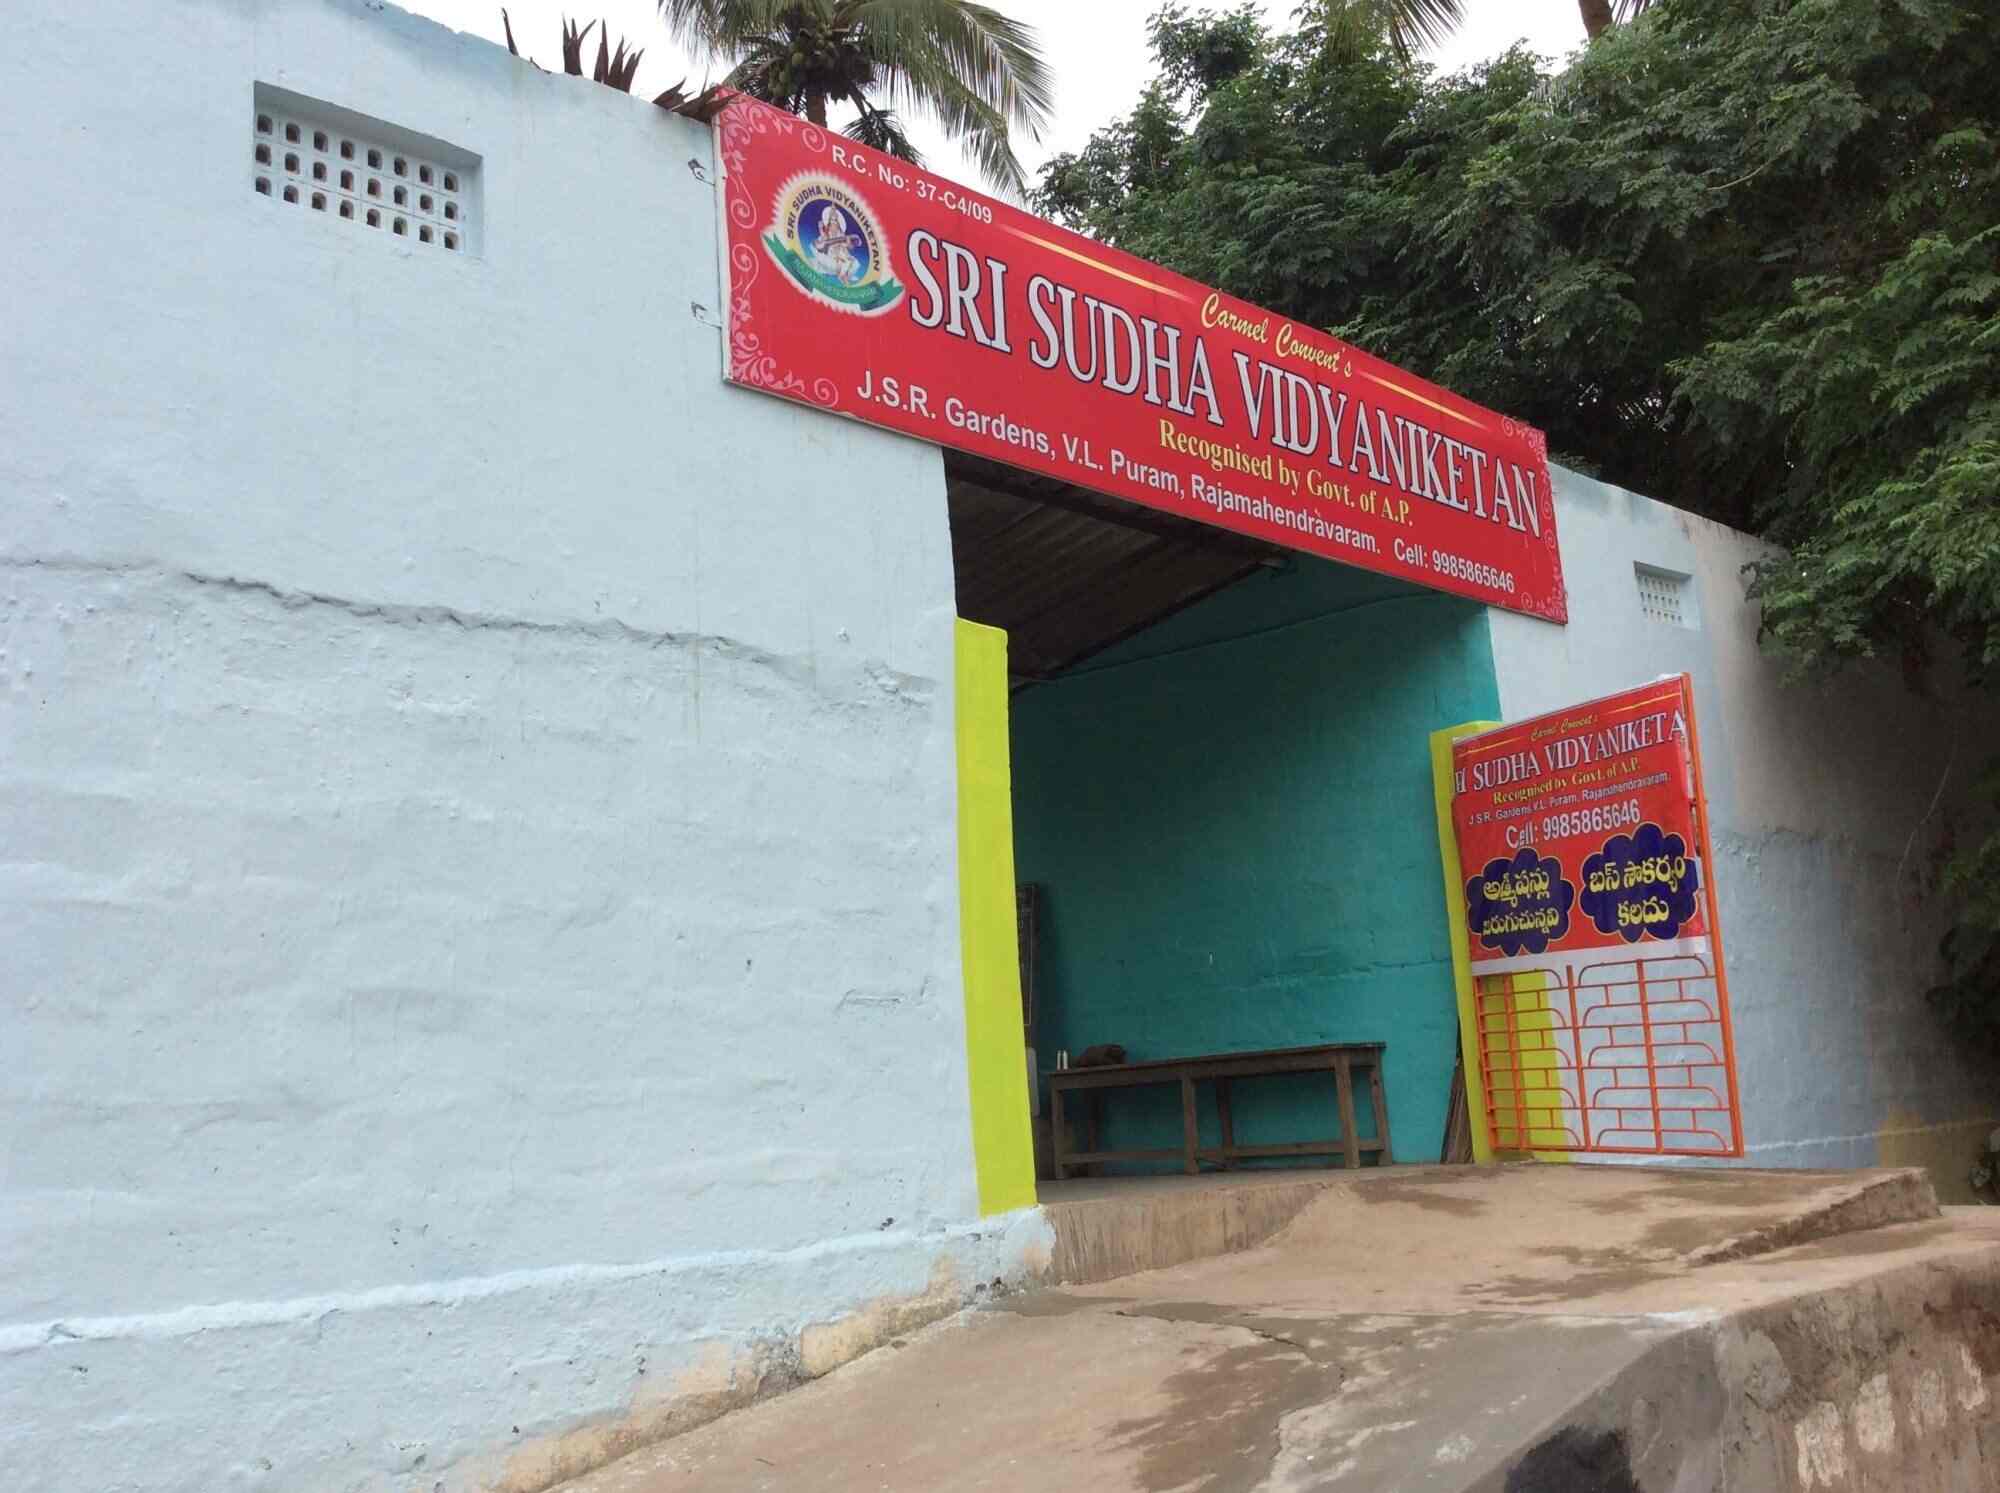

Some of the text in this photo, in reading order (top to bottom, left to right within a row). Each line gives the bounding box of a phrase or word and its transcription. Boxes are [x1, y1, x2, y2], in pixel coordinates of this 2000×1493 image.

[832, 145, 993, 224] R.C. No: 37-C4/09
[786, 185, 881, 272] SRI SUDHA VIDYANIKETAN
[1201, 292, 1353, 378] Carmel Convent's
[907, 229, 1542, 538] SRI SUDHA VIDYANIKETAN
[857, 370, 1515, 593] J.S.R. Gardens, V.L. Puram, Rajamahendravaram. Cell: 9985865646
[1159, 418, 1413, 528] Recognised by Govt. of A.P.
[1472, 751, 1541, 792] SUDHA
[1506, 799, 1641, 849] Cell: 9985865646
[1589, 862, 1620, 893] బస్
[1618, 896, 1669, 926] కలదు
